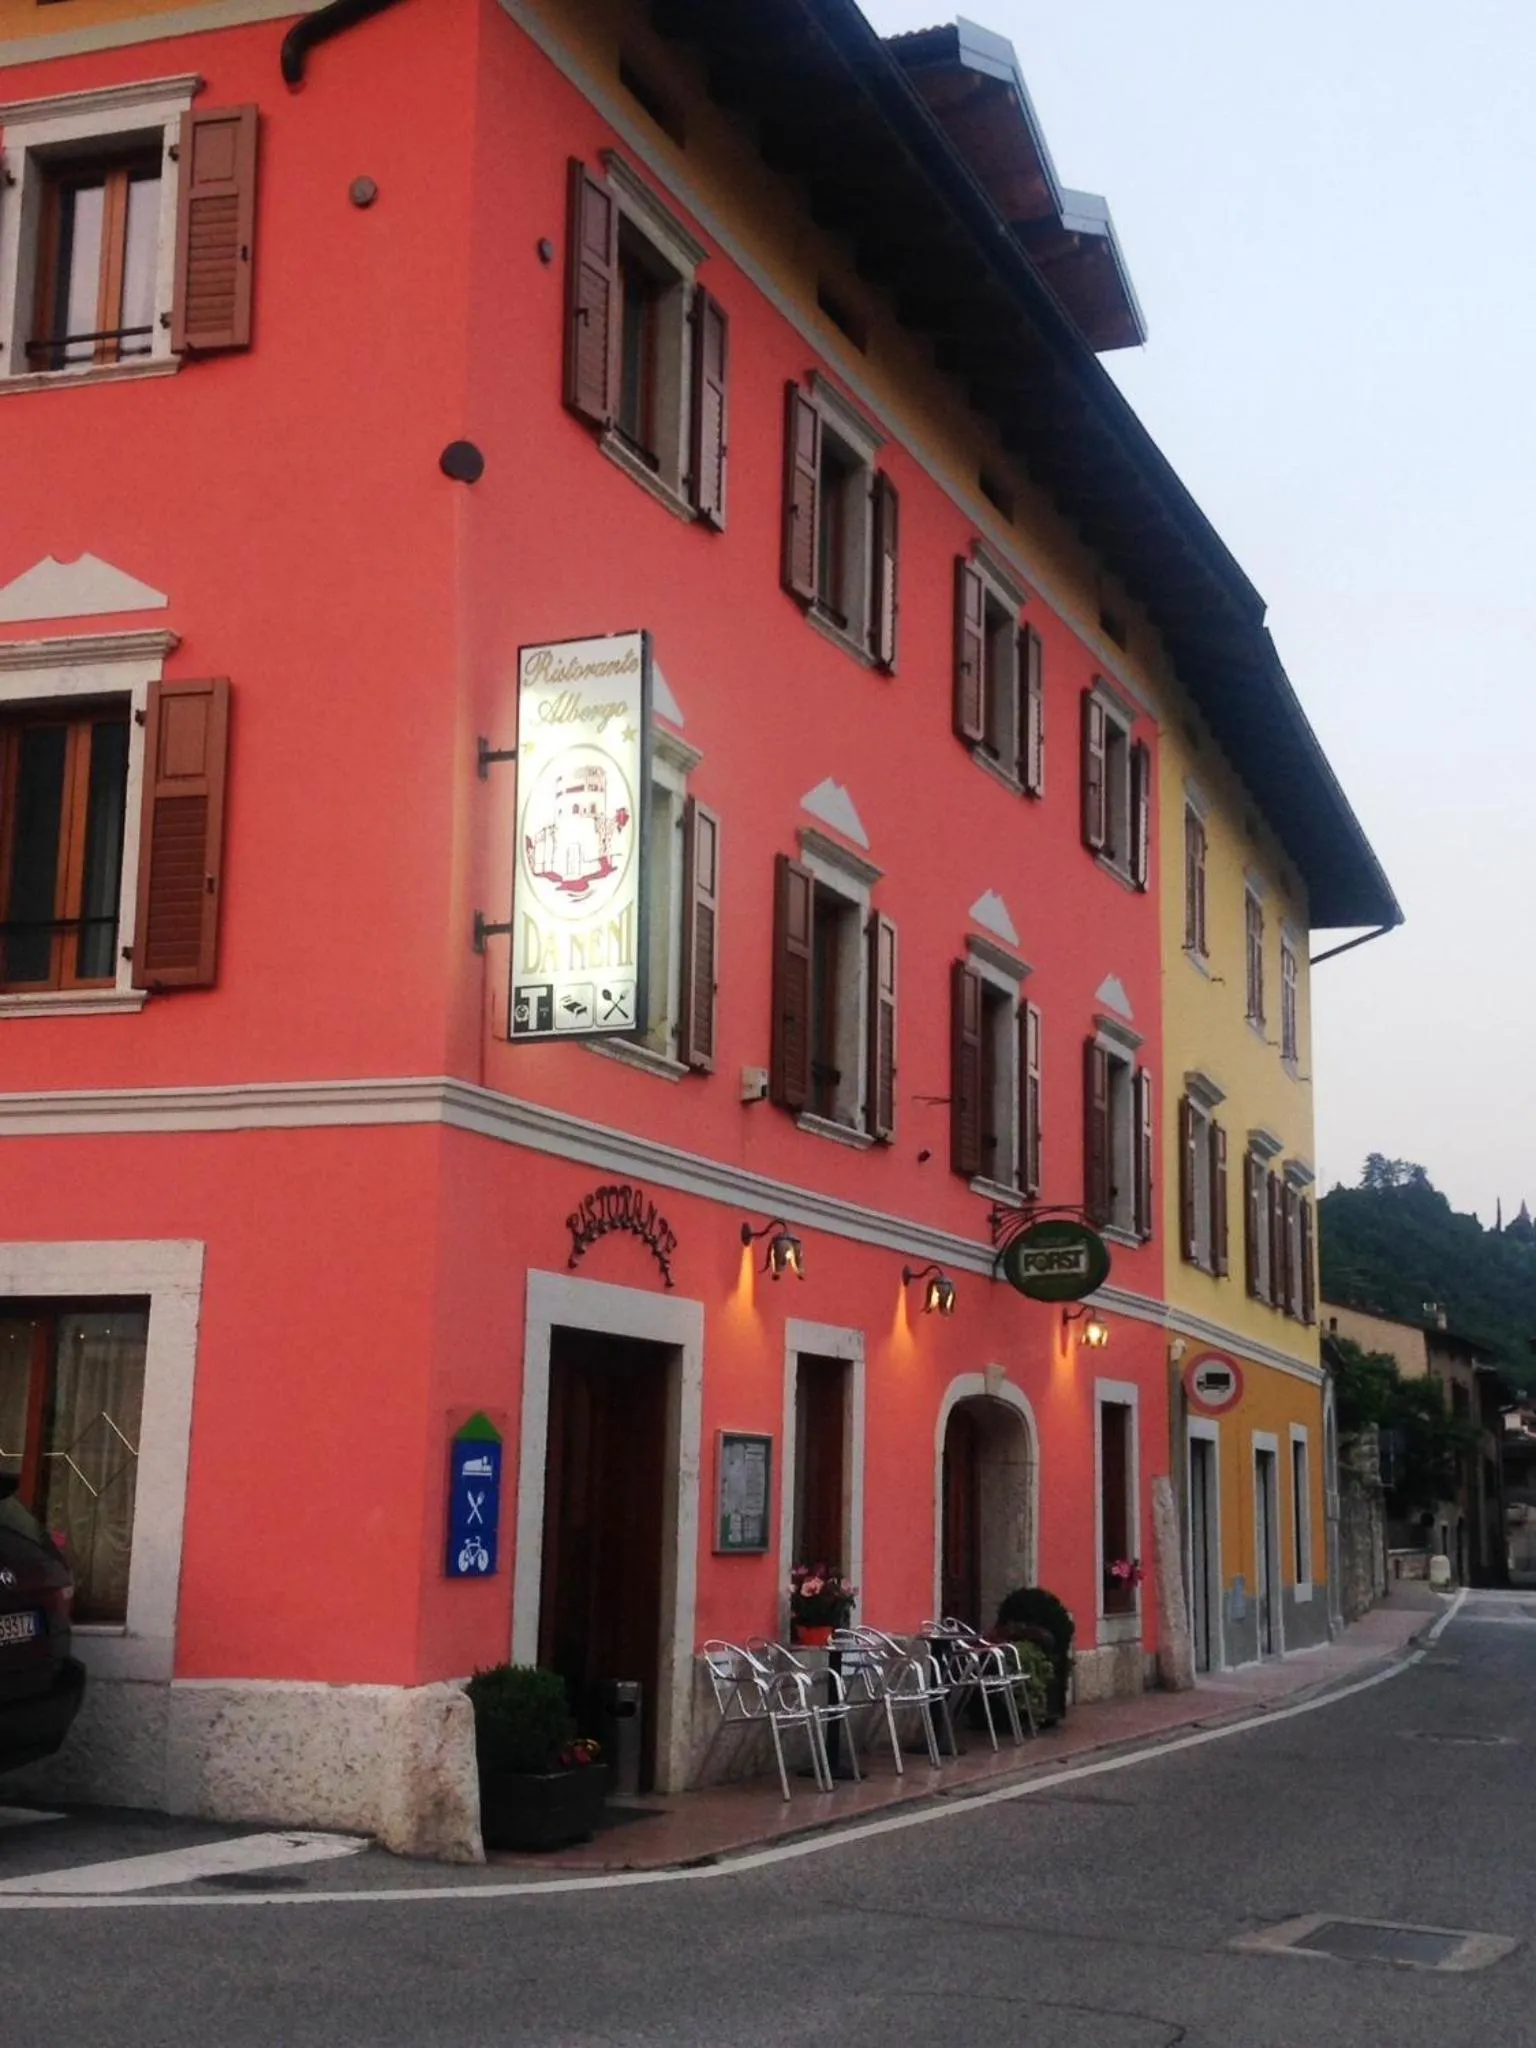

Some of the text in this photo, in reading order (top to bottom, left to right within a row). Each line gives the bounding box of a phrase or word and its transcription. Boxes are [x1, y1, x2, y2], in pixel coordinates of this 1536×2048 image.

[523, 647, 640, 687] Ristorante
[537, 690, 628, 735] Albergo
[520, 910, 560, 975] DA
[1023, 1248, 1083, 1272] FORST
